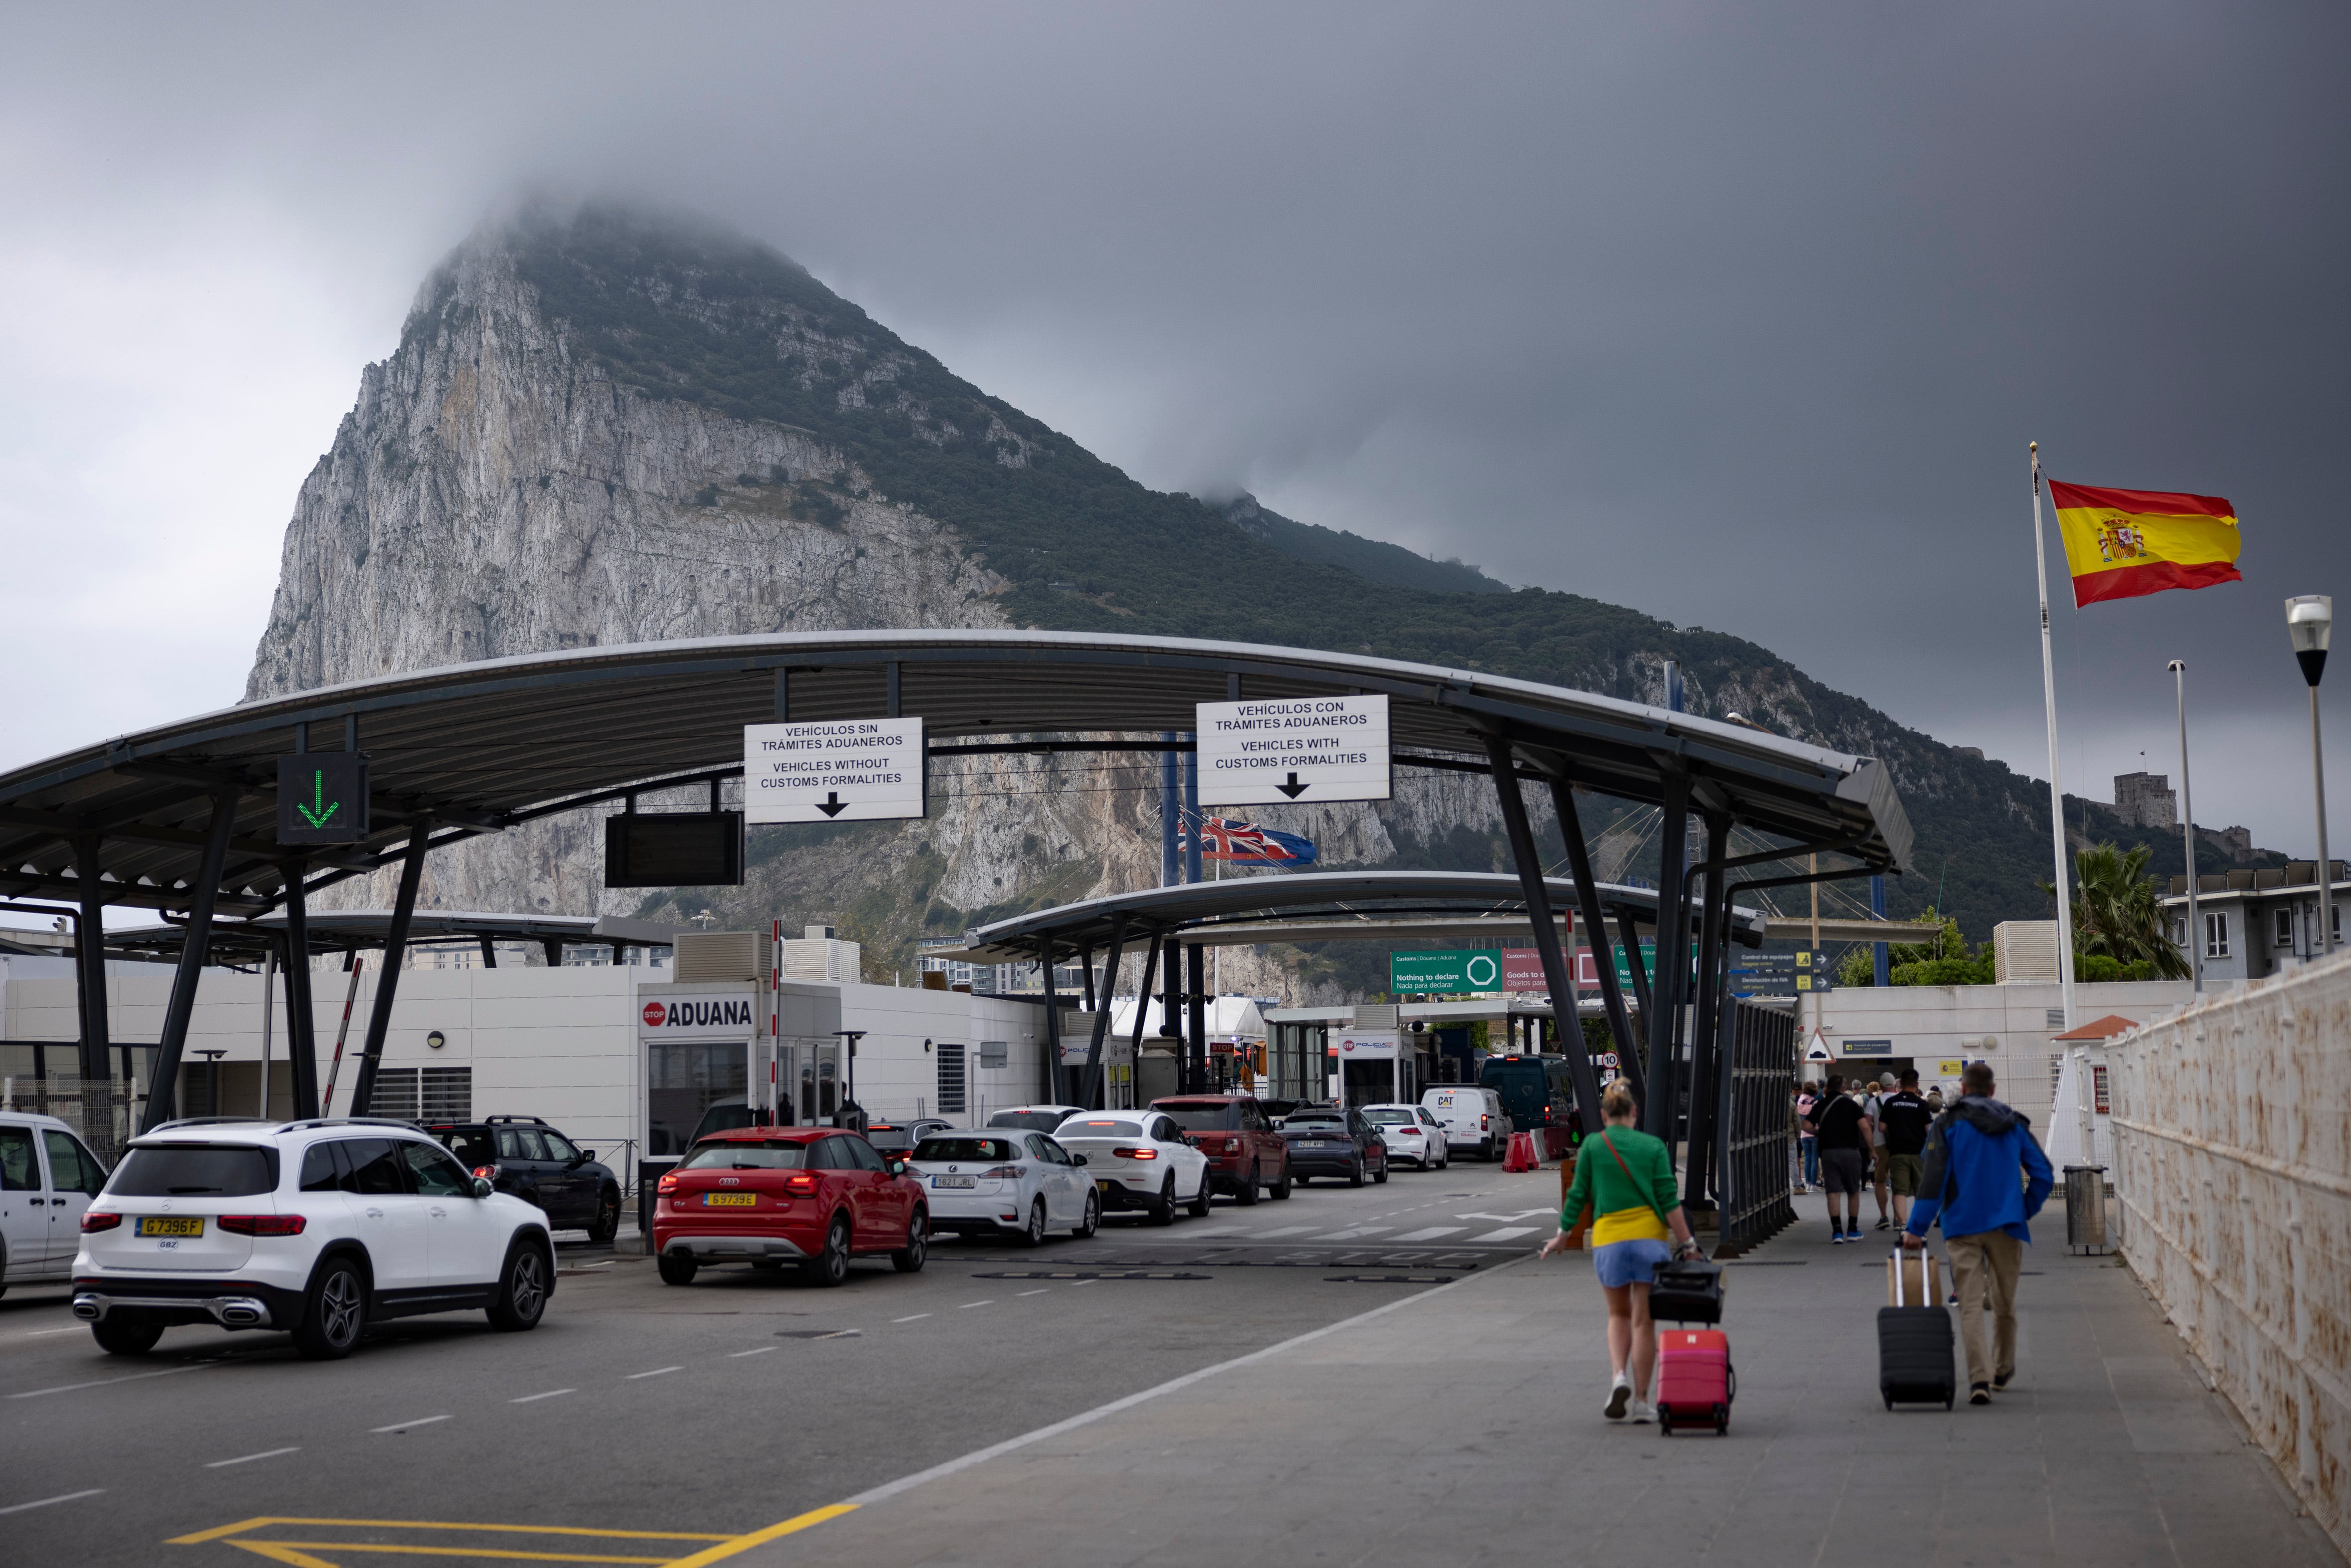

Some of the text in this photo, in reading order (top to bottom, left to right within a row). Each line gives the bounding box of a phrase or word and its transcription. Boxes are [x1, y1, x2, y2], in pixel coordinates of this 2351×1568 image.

[1238, 702, 1344, 716] VEHÍCULOS CON
[1215, 714, 1367, 731] TRÁMITES ADUANEROS
[786, 724, 878, 737] VEHÍCULOS SIN
[762, 736, 903, 751] TRÁMITES ADUANEROS
[1241, 738, 1339, 751] VEHICLES WITH
[773, 758, 890, 772] VEHICLES WITHOUT
[1215, 753, 1367, 769] CUSTOMS FORMALITIES
[761, 773, 901, 788] CUSTOMS FORMALITIES
[667, 1001, 752, 1027] ADUANA
[1604, 1056, 1616, 1064] 10
[1438, 1096, 1453, 1105] CAT
